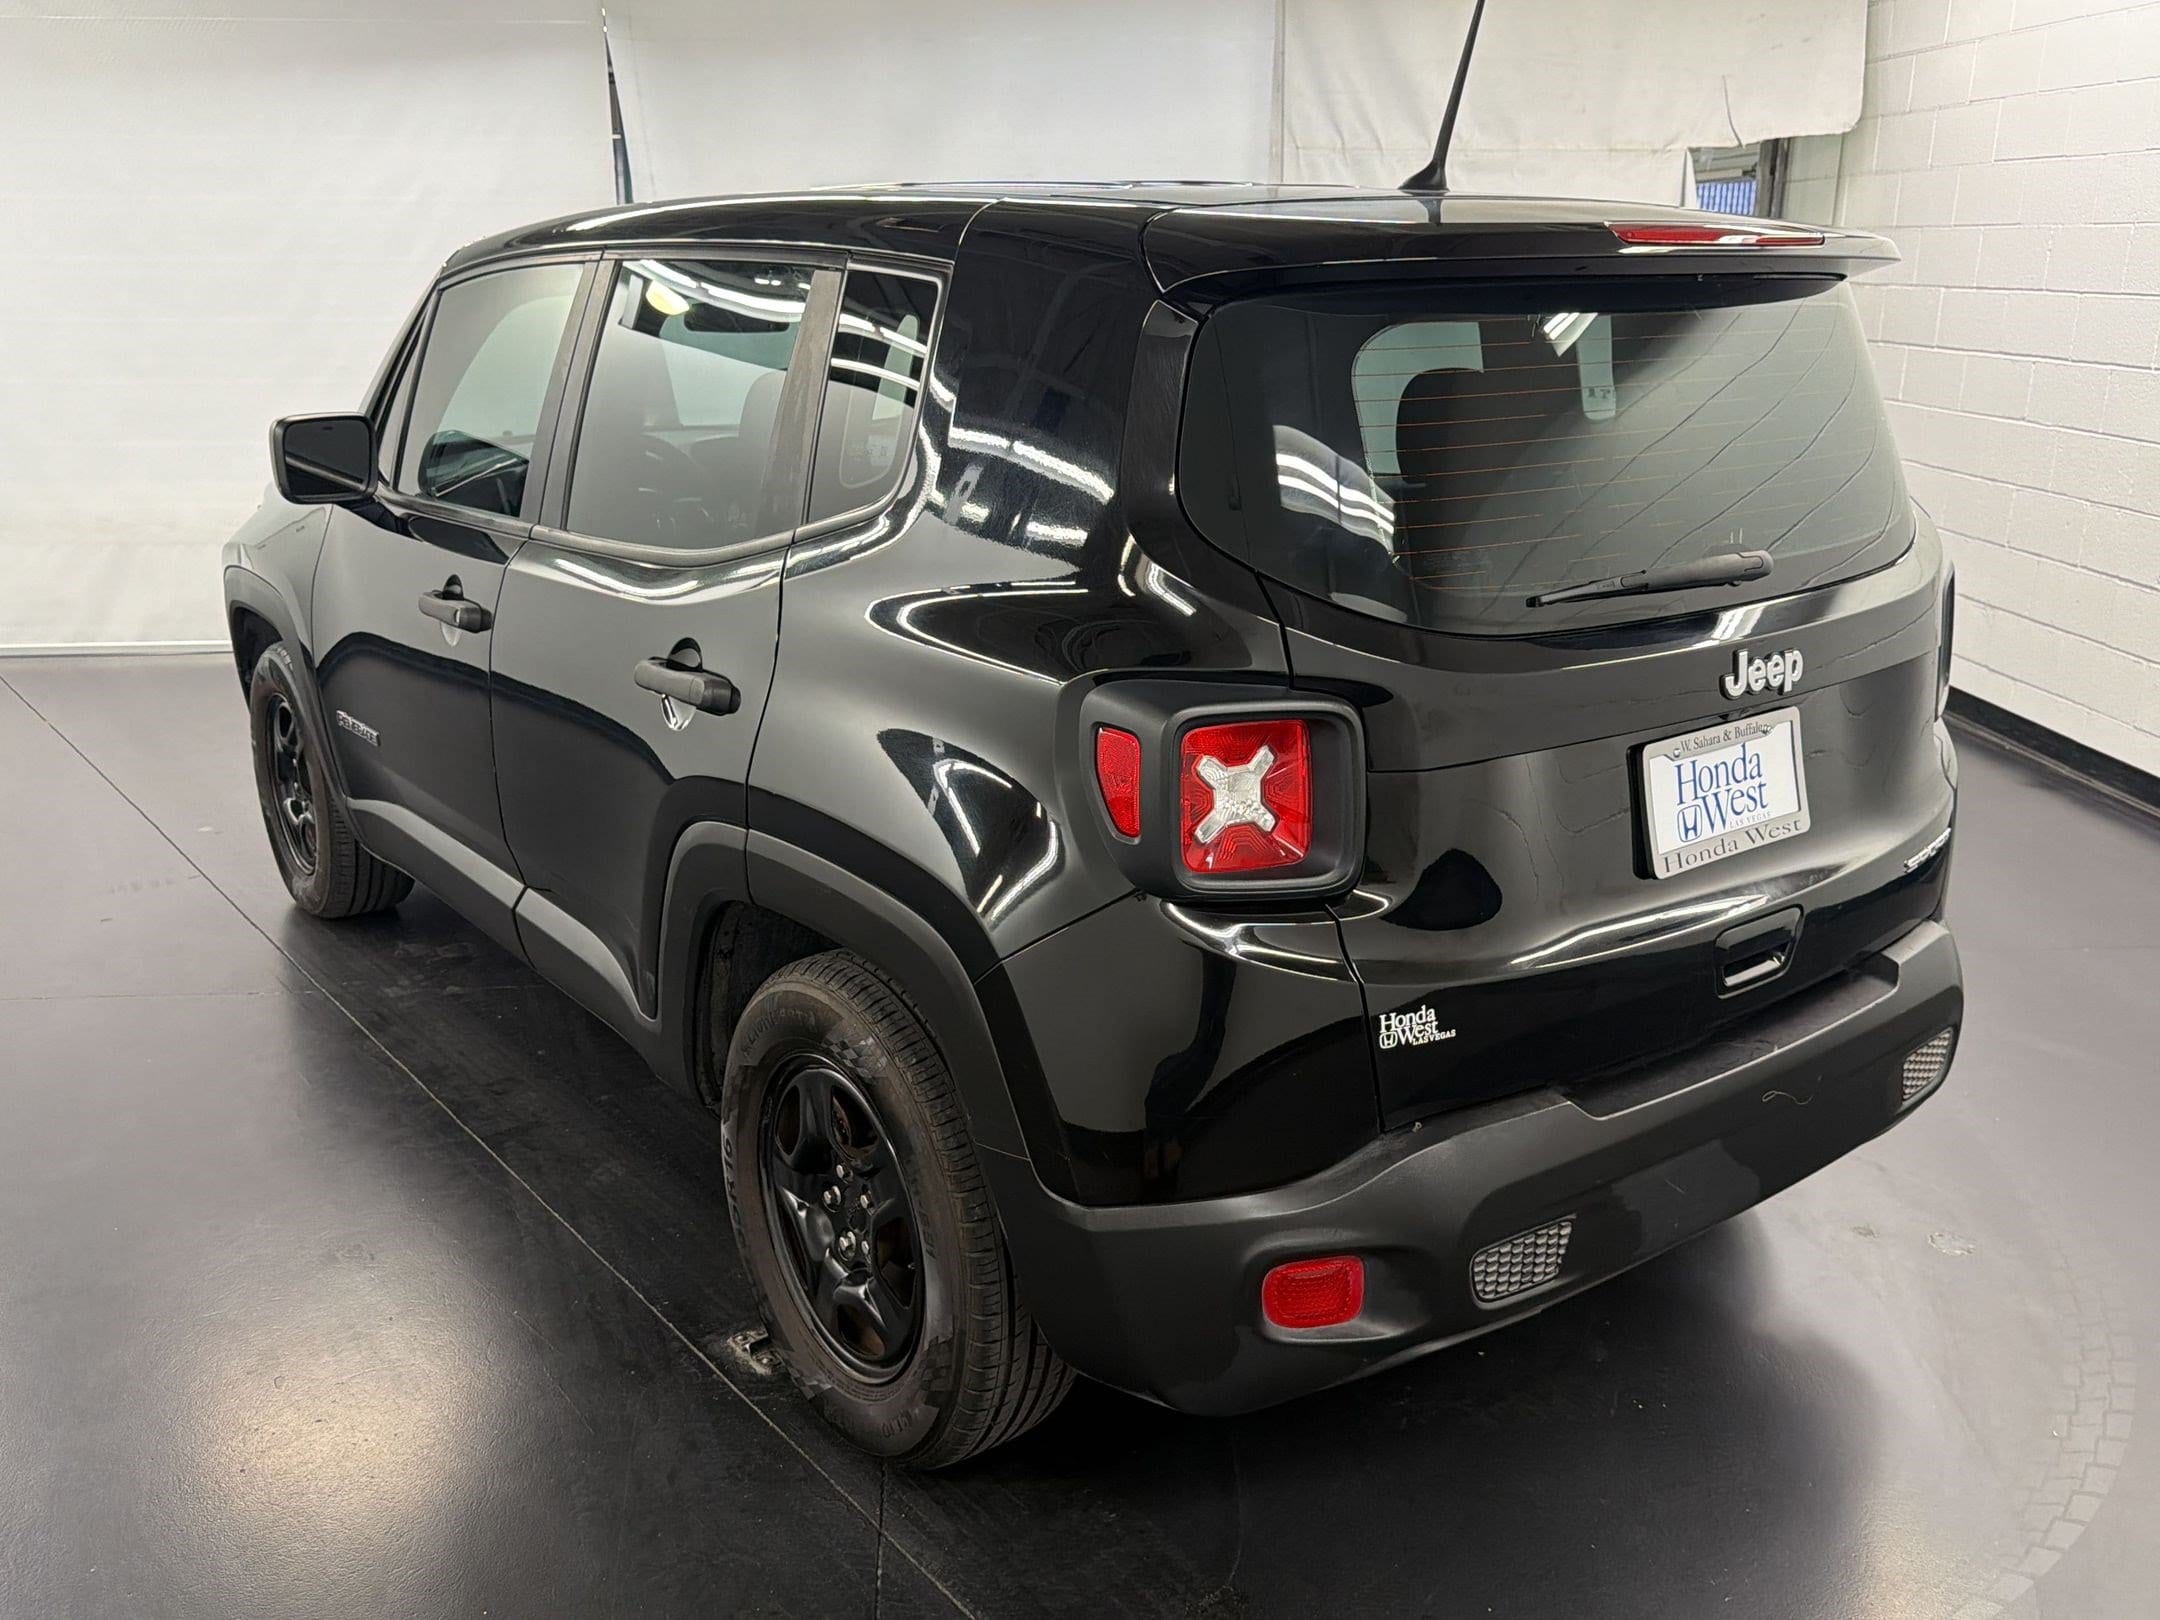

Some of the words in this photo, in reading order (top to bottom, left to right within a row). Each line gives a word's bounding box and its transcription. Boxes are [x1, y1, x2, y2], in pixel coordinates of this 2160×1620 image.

[1722, 649, 1803, 698] Jeep
[1693, 734, 1721, 750] Sahara
[1723, 729, 1732, 742] &
[1674, 742, 1763, 806] Honda
[1697, 781, 1769, 834] West
[1664, 838, 1739, 873] Honda
[1744, 819, 1801, 844] West
[1379, 1004, 1436, 1033] Honda
[1396, 1021, 1439, 1046] West
[1428, 1029, 1457, 1042] VEGAS
